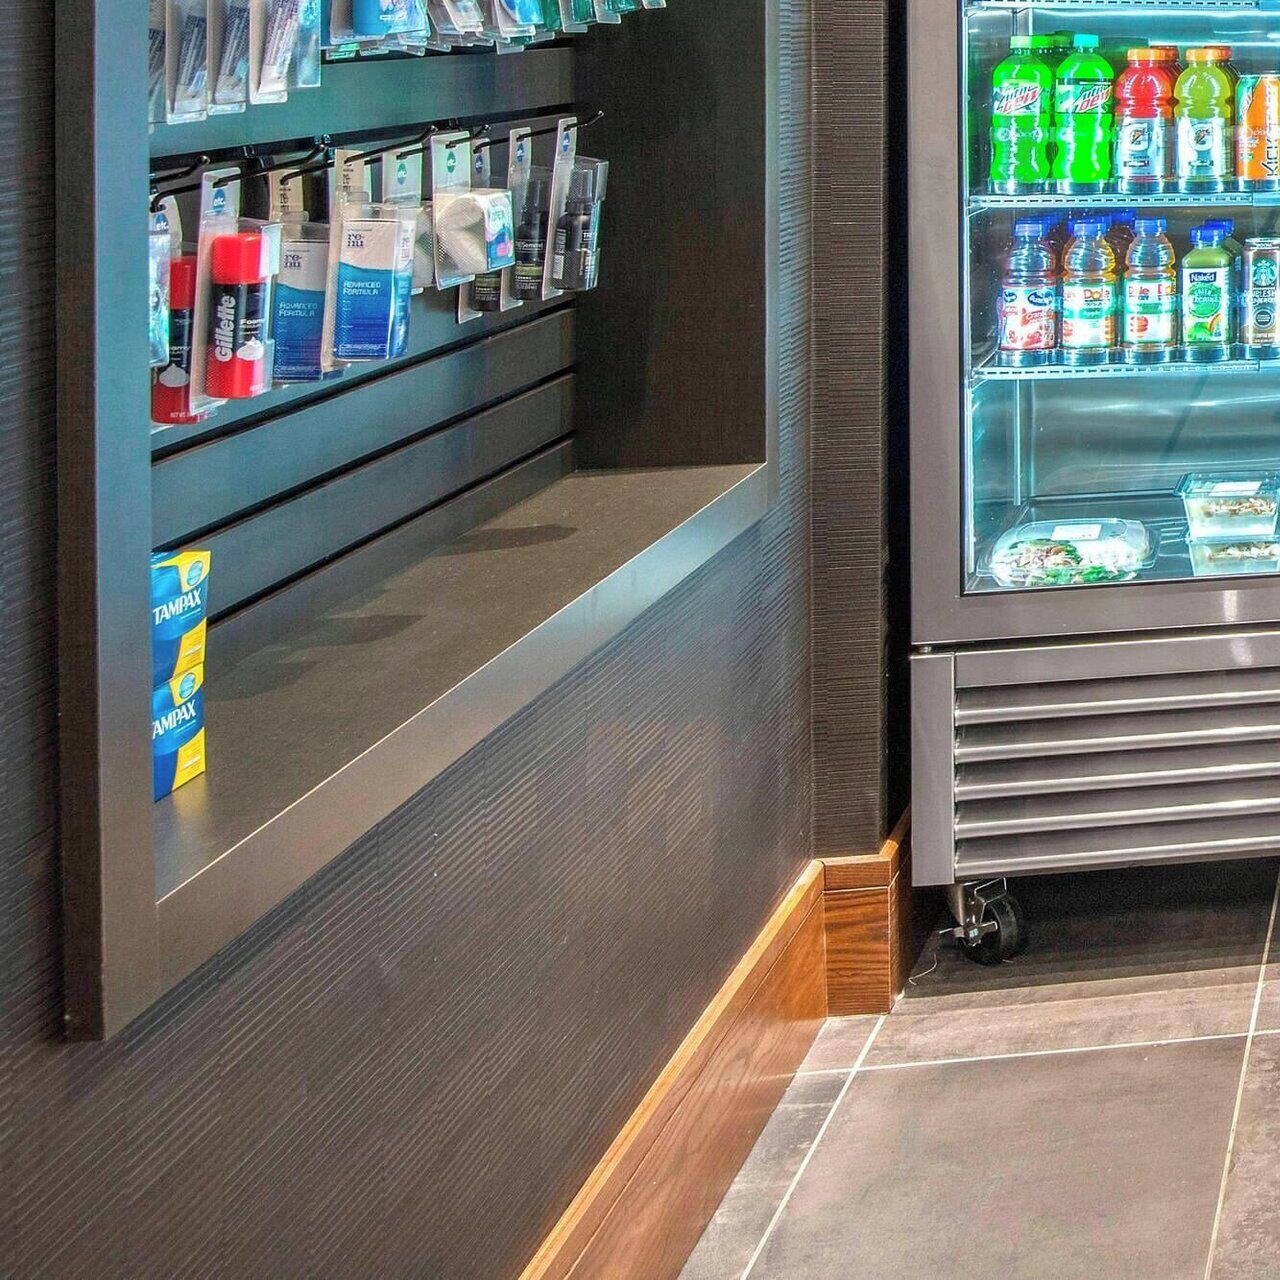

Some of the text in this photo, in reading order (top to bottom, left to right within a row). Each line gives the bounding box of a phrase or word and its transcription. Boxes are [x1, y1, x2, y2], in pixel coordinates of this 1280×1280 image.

[343, 281, 381, 289] ADVANCED
[343, 288, 379, 296] FORMULA
[214, 294, 236, 363] Gillette
[152, 587, 202, 625] TAMPAX
